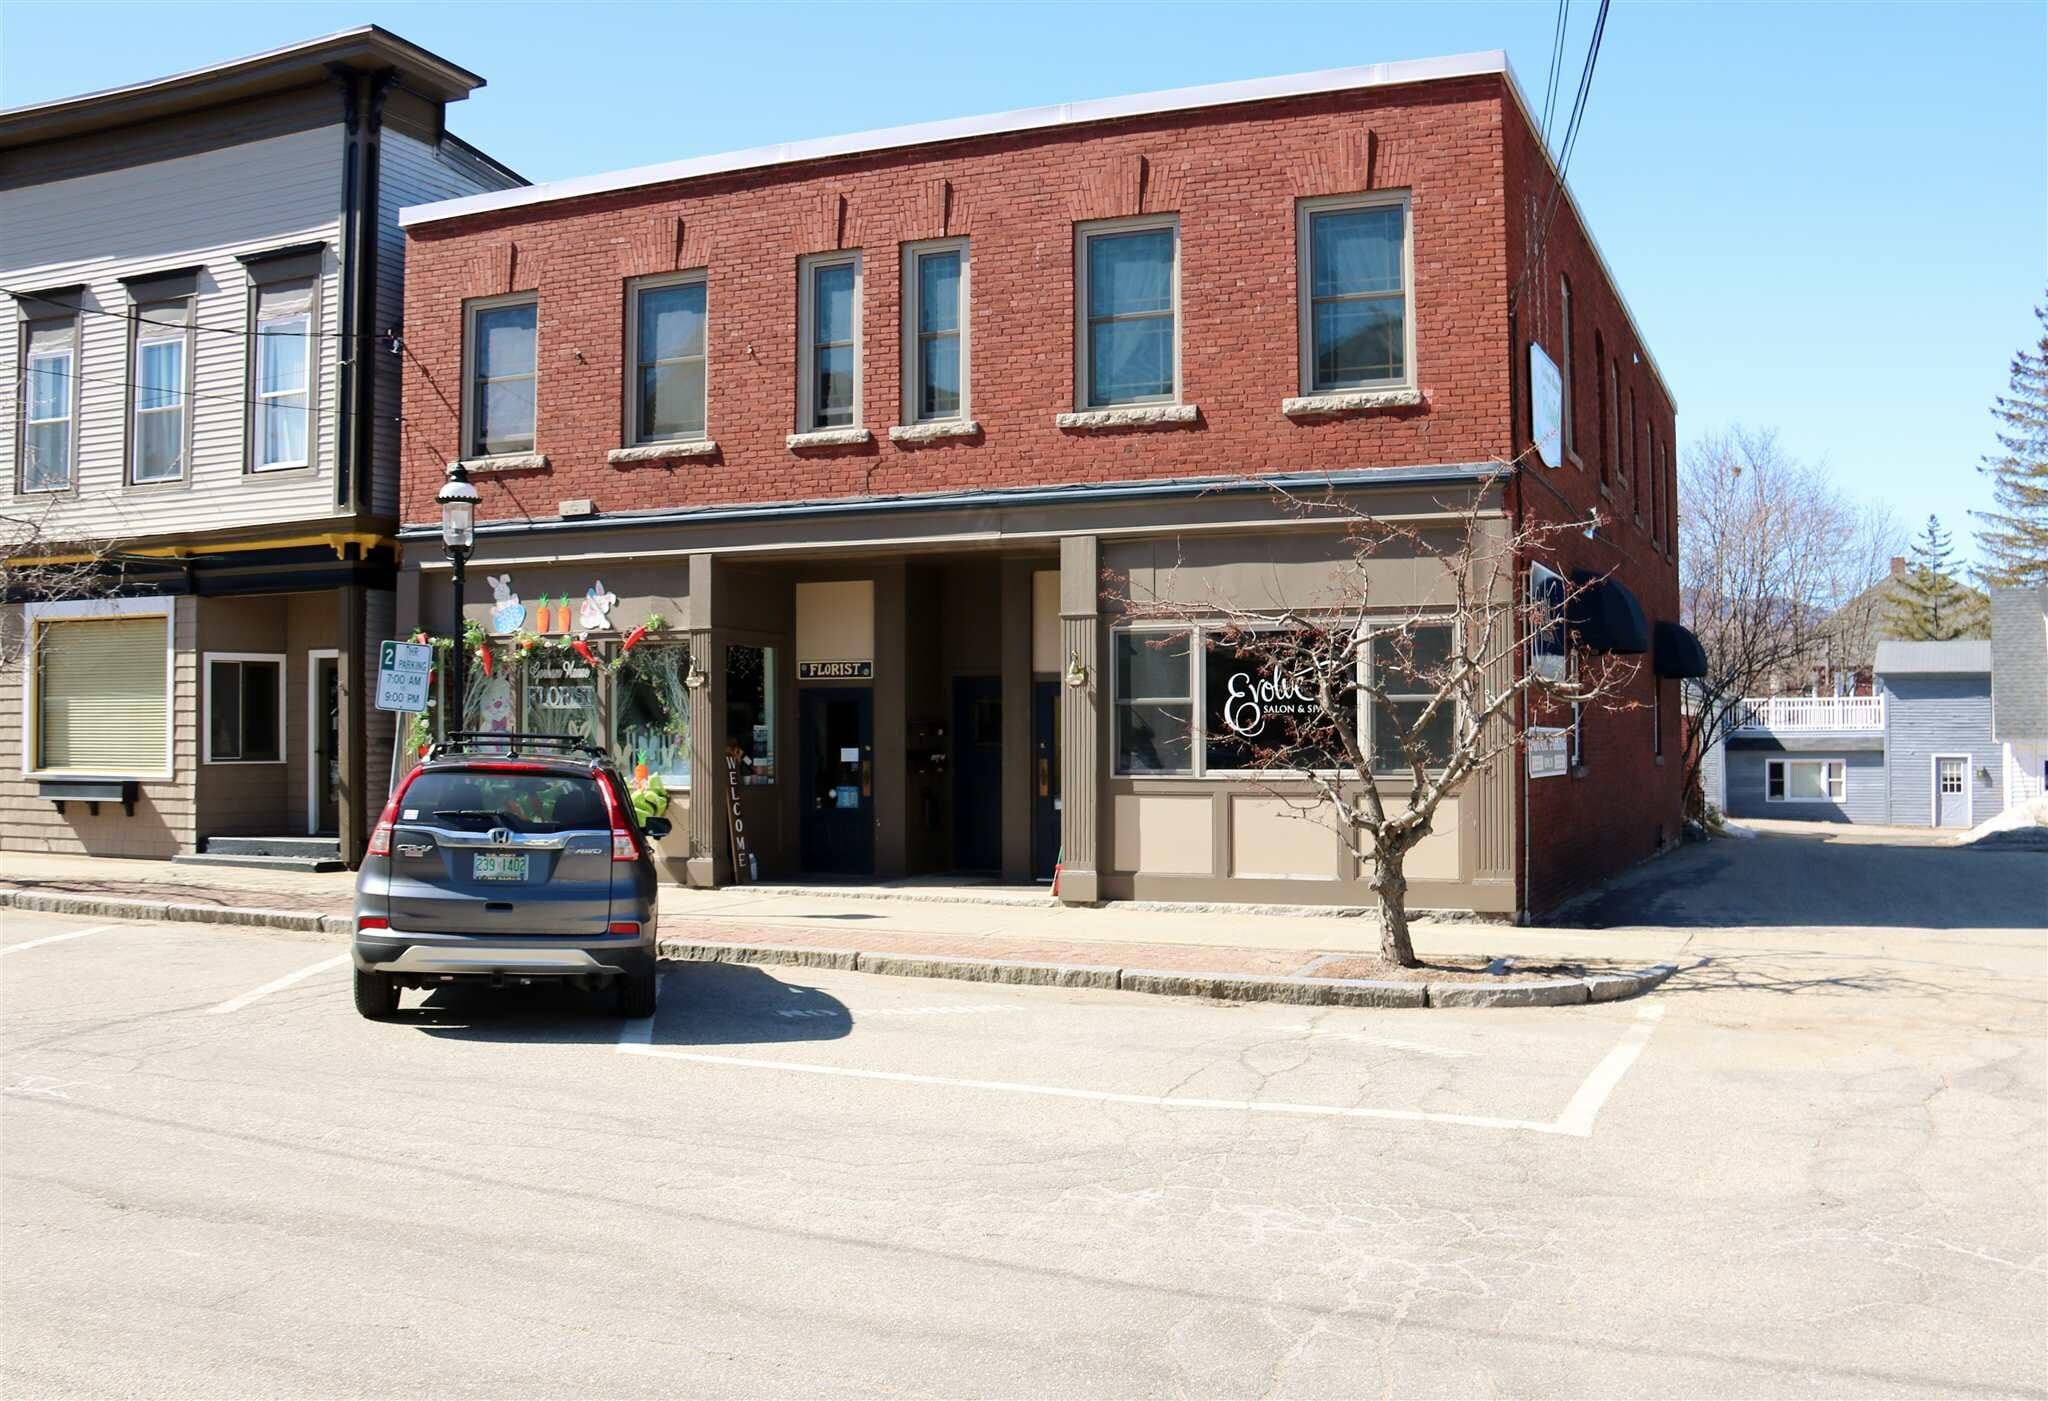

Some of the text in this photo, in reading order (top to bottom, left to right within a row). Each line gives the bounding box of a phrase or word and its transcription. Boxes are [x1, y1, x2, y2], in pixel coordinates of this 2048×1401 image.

[384, 648, 395, 665] 2
[399, 658, 427, 671] PARKING
[809, 663, 861, 677] FLORIST
[384, 673, 421, 686] 7:00 AM
[384, 691, 420, 704] 9:00 PM
[1263, 704, 1295, 714] SALON
[1297, 704, 1305, 714] &
[726, 756, 746, 867] WELCOME
[475, 858, 526, 873] 239 1402
